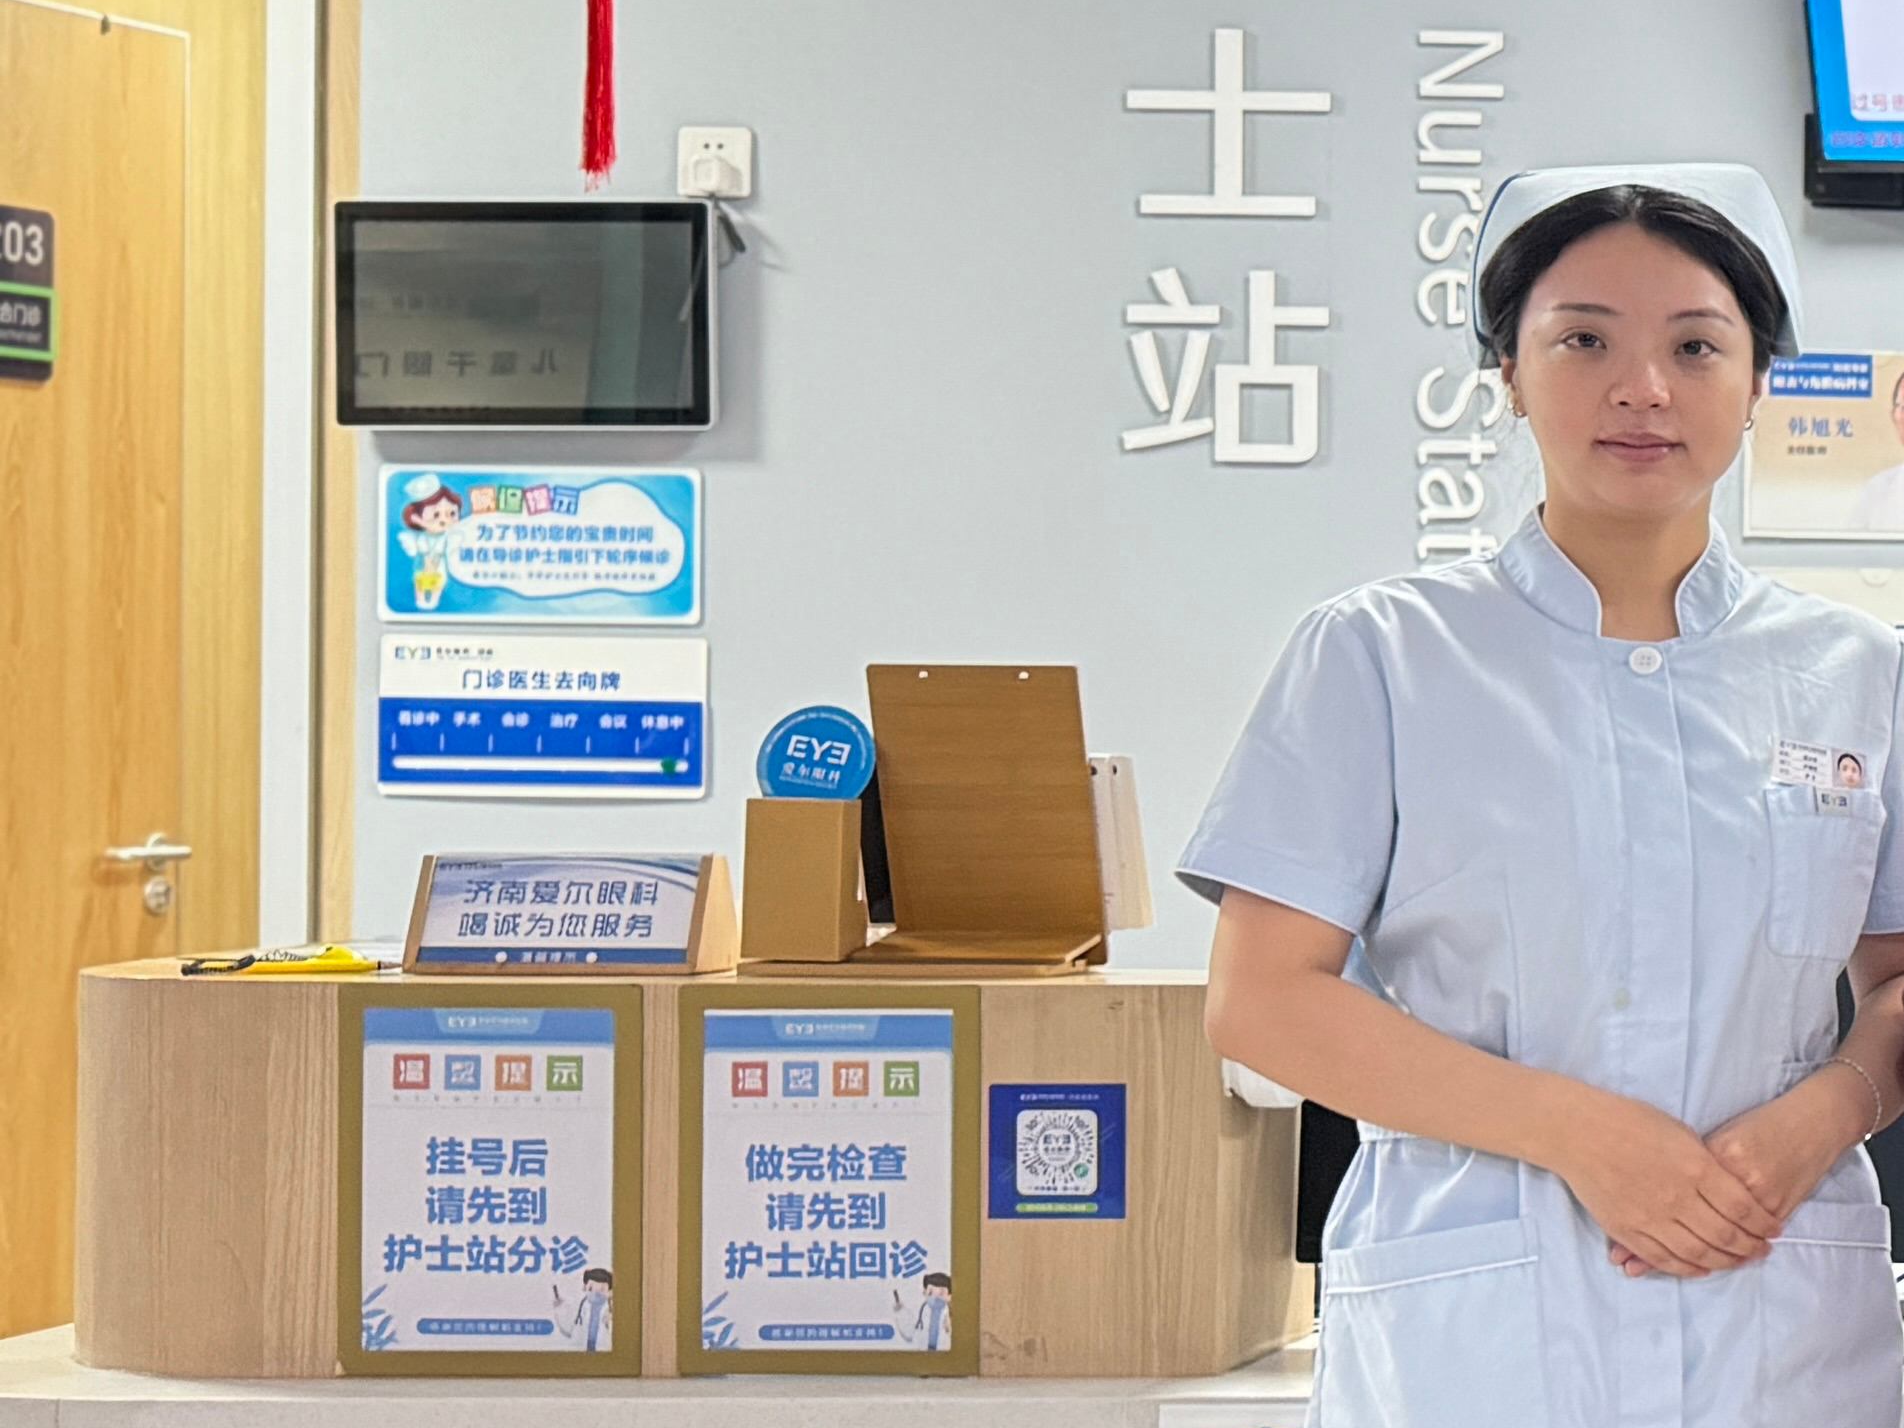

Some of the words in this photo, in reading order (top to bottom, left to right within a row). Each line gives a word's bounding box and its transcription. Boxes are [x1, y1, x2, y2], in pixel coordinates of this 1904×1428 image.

[1415, 29, 1506, 329] Nurse
[0, 220, 44, 265] 03
[1788, 416, 1853, 439] 韩旭光
[477, 525, 653, 543] 为了节约您的宝贵时间
[463, 669, 621, 691] 门诊医生去向牌
[550, 712, 579, 729] 治疗
[599, 713, 627, 730] 会议
[641, 714, 684, 730] 休息中
[787, 735, 851, 766] EYE
[463, 879, 659, 905] 济南爱尔眼科
[457, 912, 653, 937] 竭诚为您服务
[427, 1137, 548, 1177] 挂号后
[746, 1144, 907, 1182] 做完检查
[426, 1186, 547, 1225] 请先到
[766, 1192, 886, 1231] 请先到
[383, 1234, 589, 1273] 护士站分诊
[725, 1241, 928, 1280] 护士站回诊
